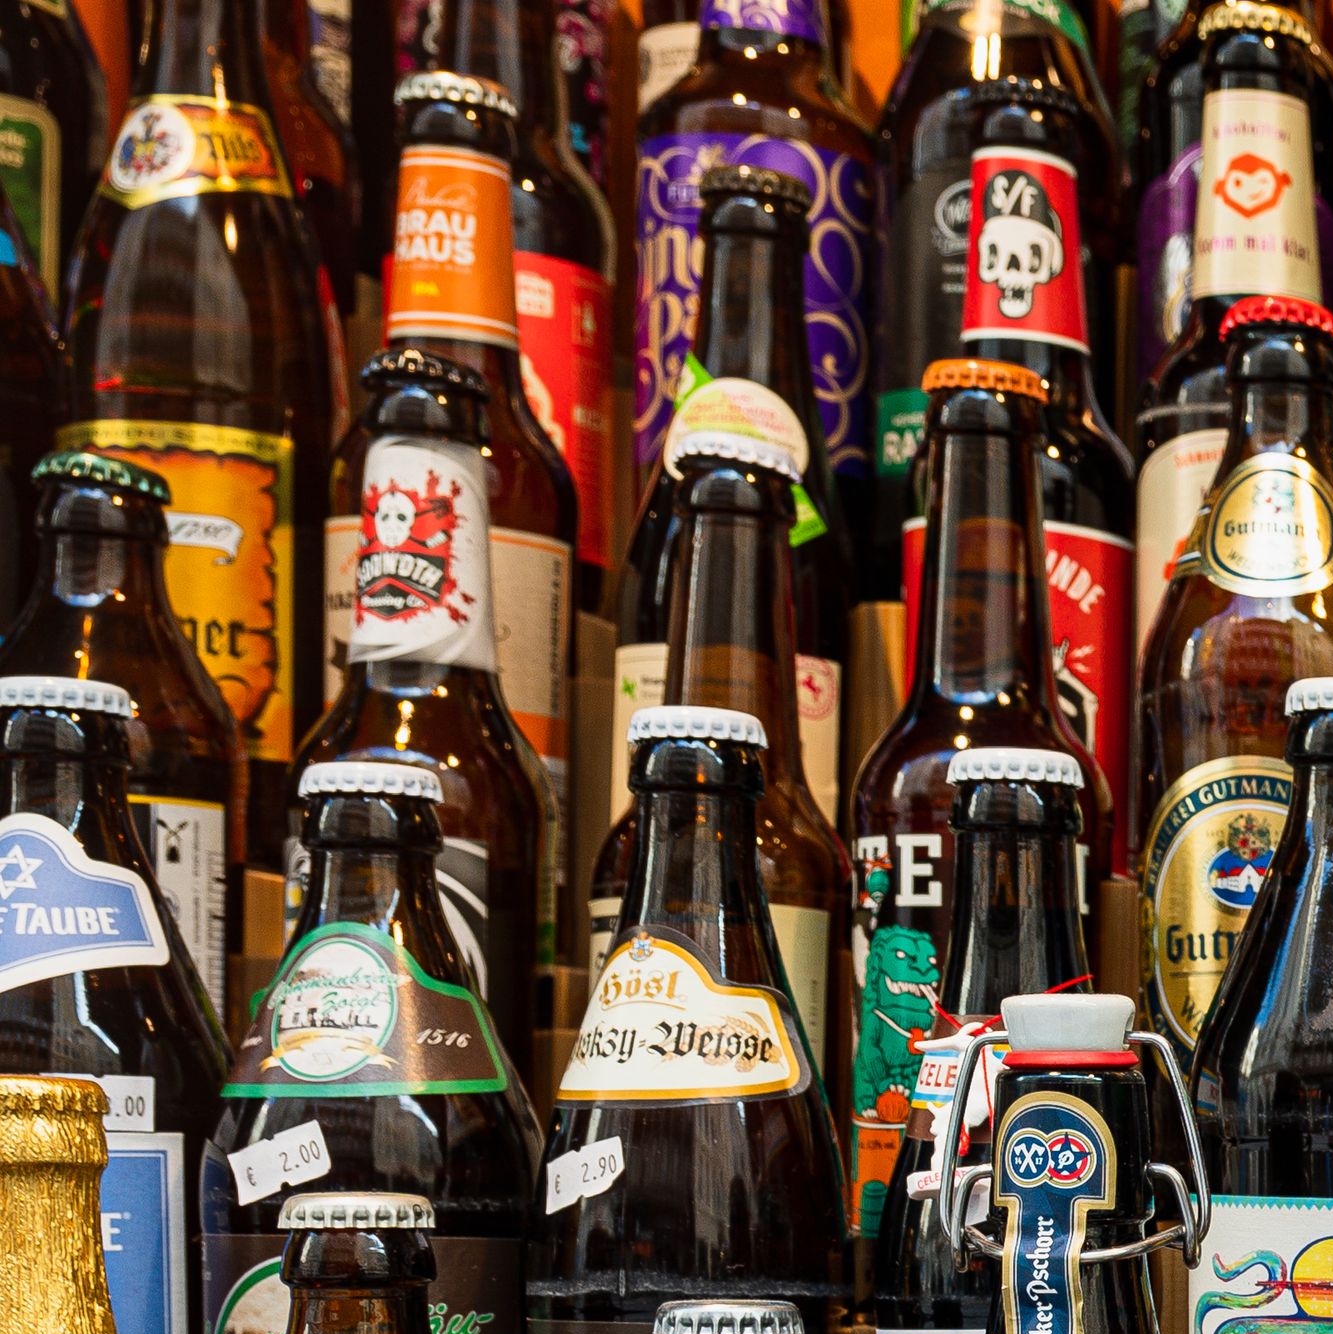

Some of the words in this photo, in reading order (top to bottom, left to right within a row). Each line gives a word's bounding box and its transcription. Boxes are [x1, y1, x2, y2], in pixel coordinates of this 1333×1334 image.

[13, 905, 119, 936] TAUBE
[417, 1027, 472, 1050] 1516
[246, 1166, 256, 1188] €
[278, 1139, 322, 1174] 2.00
[553, 1174, 563, 1194] €
[581, 1153, 619, 1183] 2.90
